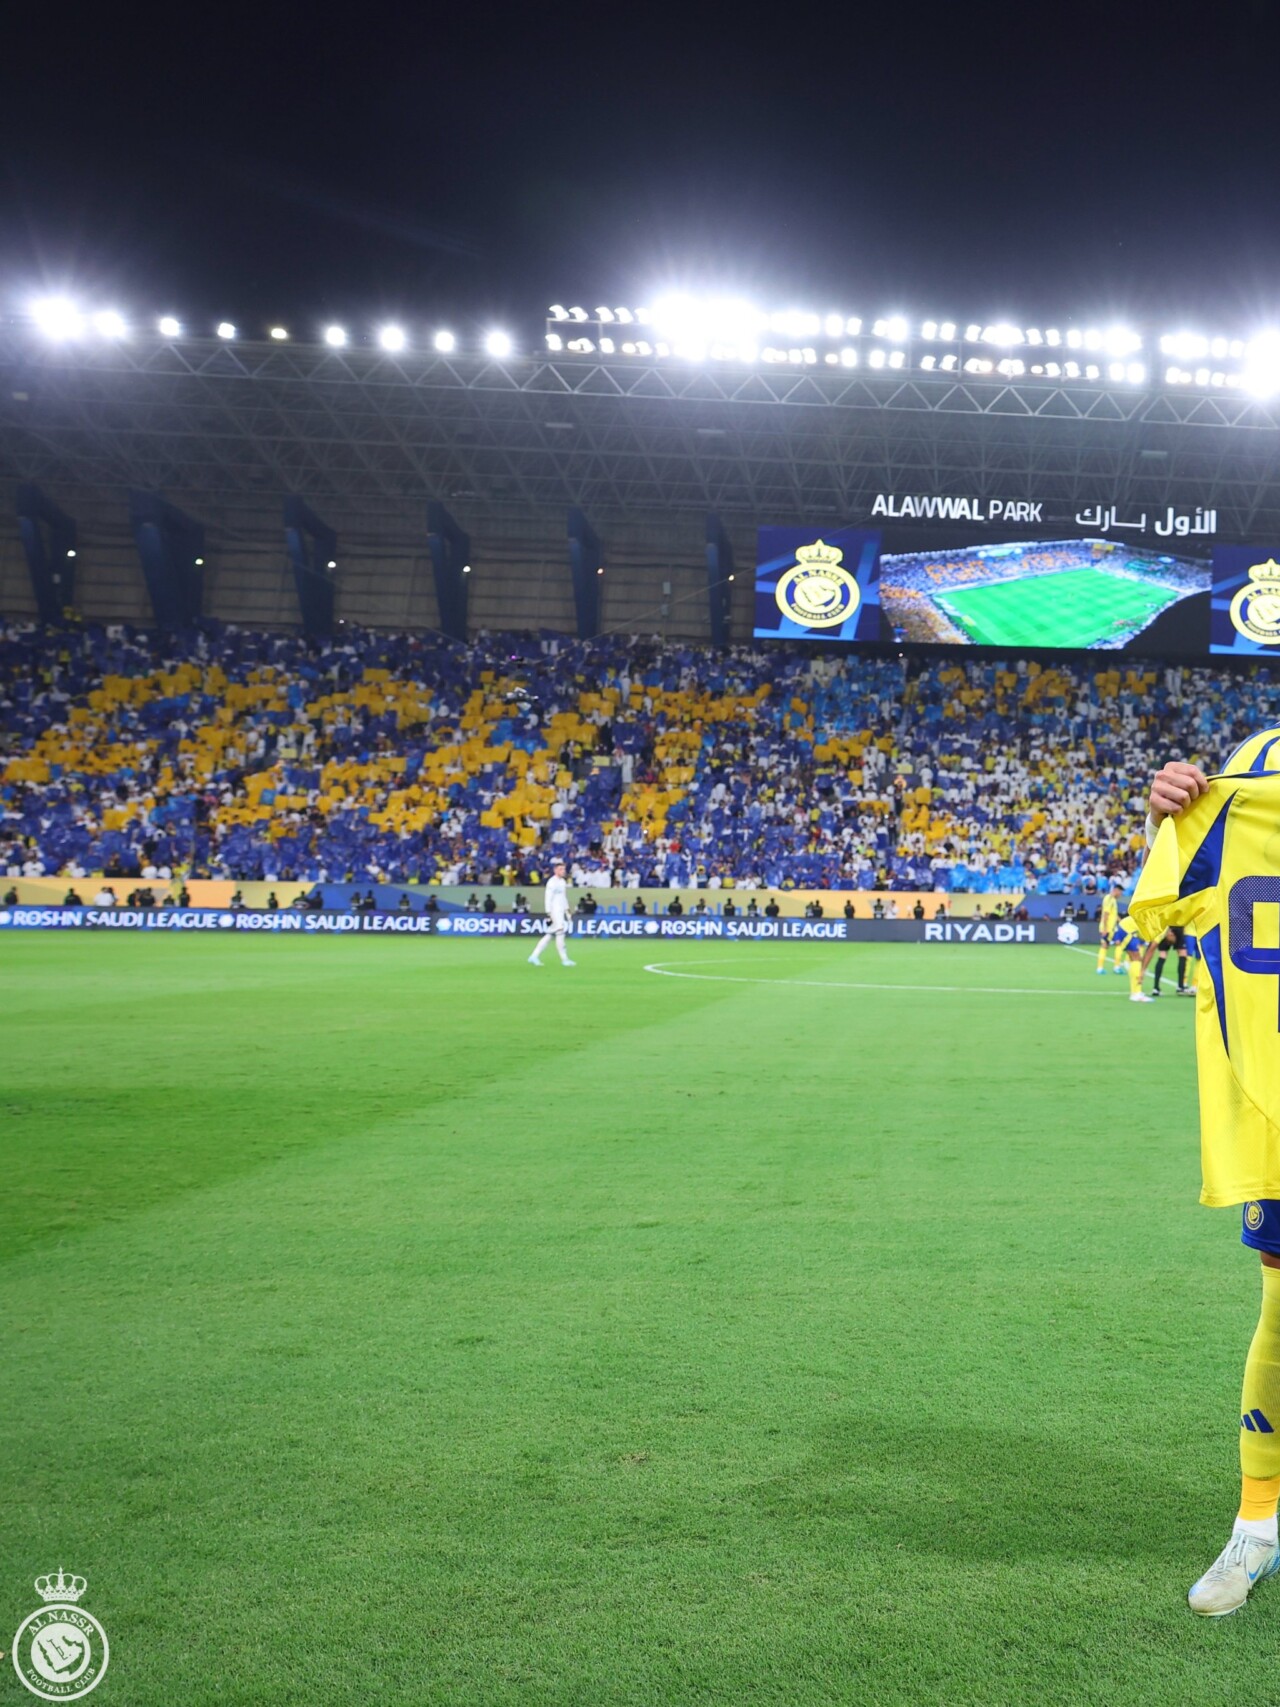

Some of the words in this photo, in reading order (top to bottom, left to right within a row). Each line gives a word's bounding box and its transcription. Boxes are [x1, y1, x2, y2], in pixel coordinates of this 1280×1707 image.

[871, 494, 985, 521] ALAWWAL
[988, 499, 1043, 523] PARK
[1154, 506, 1217, 537] الأول
[13, 910, 82, 926] ROSHN
[86, 911, 144, 927] SAUDI
[146, 912, 217, 928] LEAGUE
[235, 913, 302, 930] ROSHN
[305, 914, 360, 930] SAUDI
[363, 915, 431, 932] LEAGUE
[453, 917, 517, 933] ROSHN
[577, 919, 643, 935] LEAGUE
[661, 920, 723, 936] ROSHN
[726, 921, 779, 937] SAUDI
[782, 922, 847, 938] LEAGUE
[924, 923, 1035, 942] RIYADH
